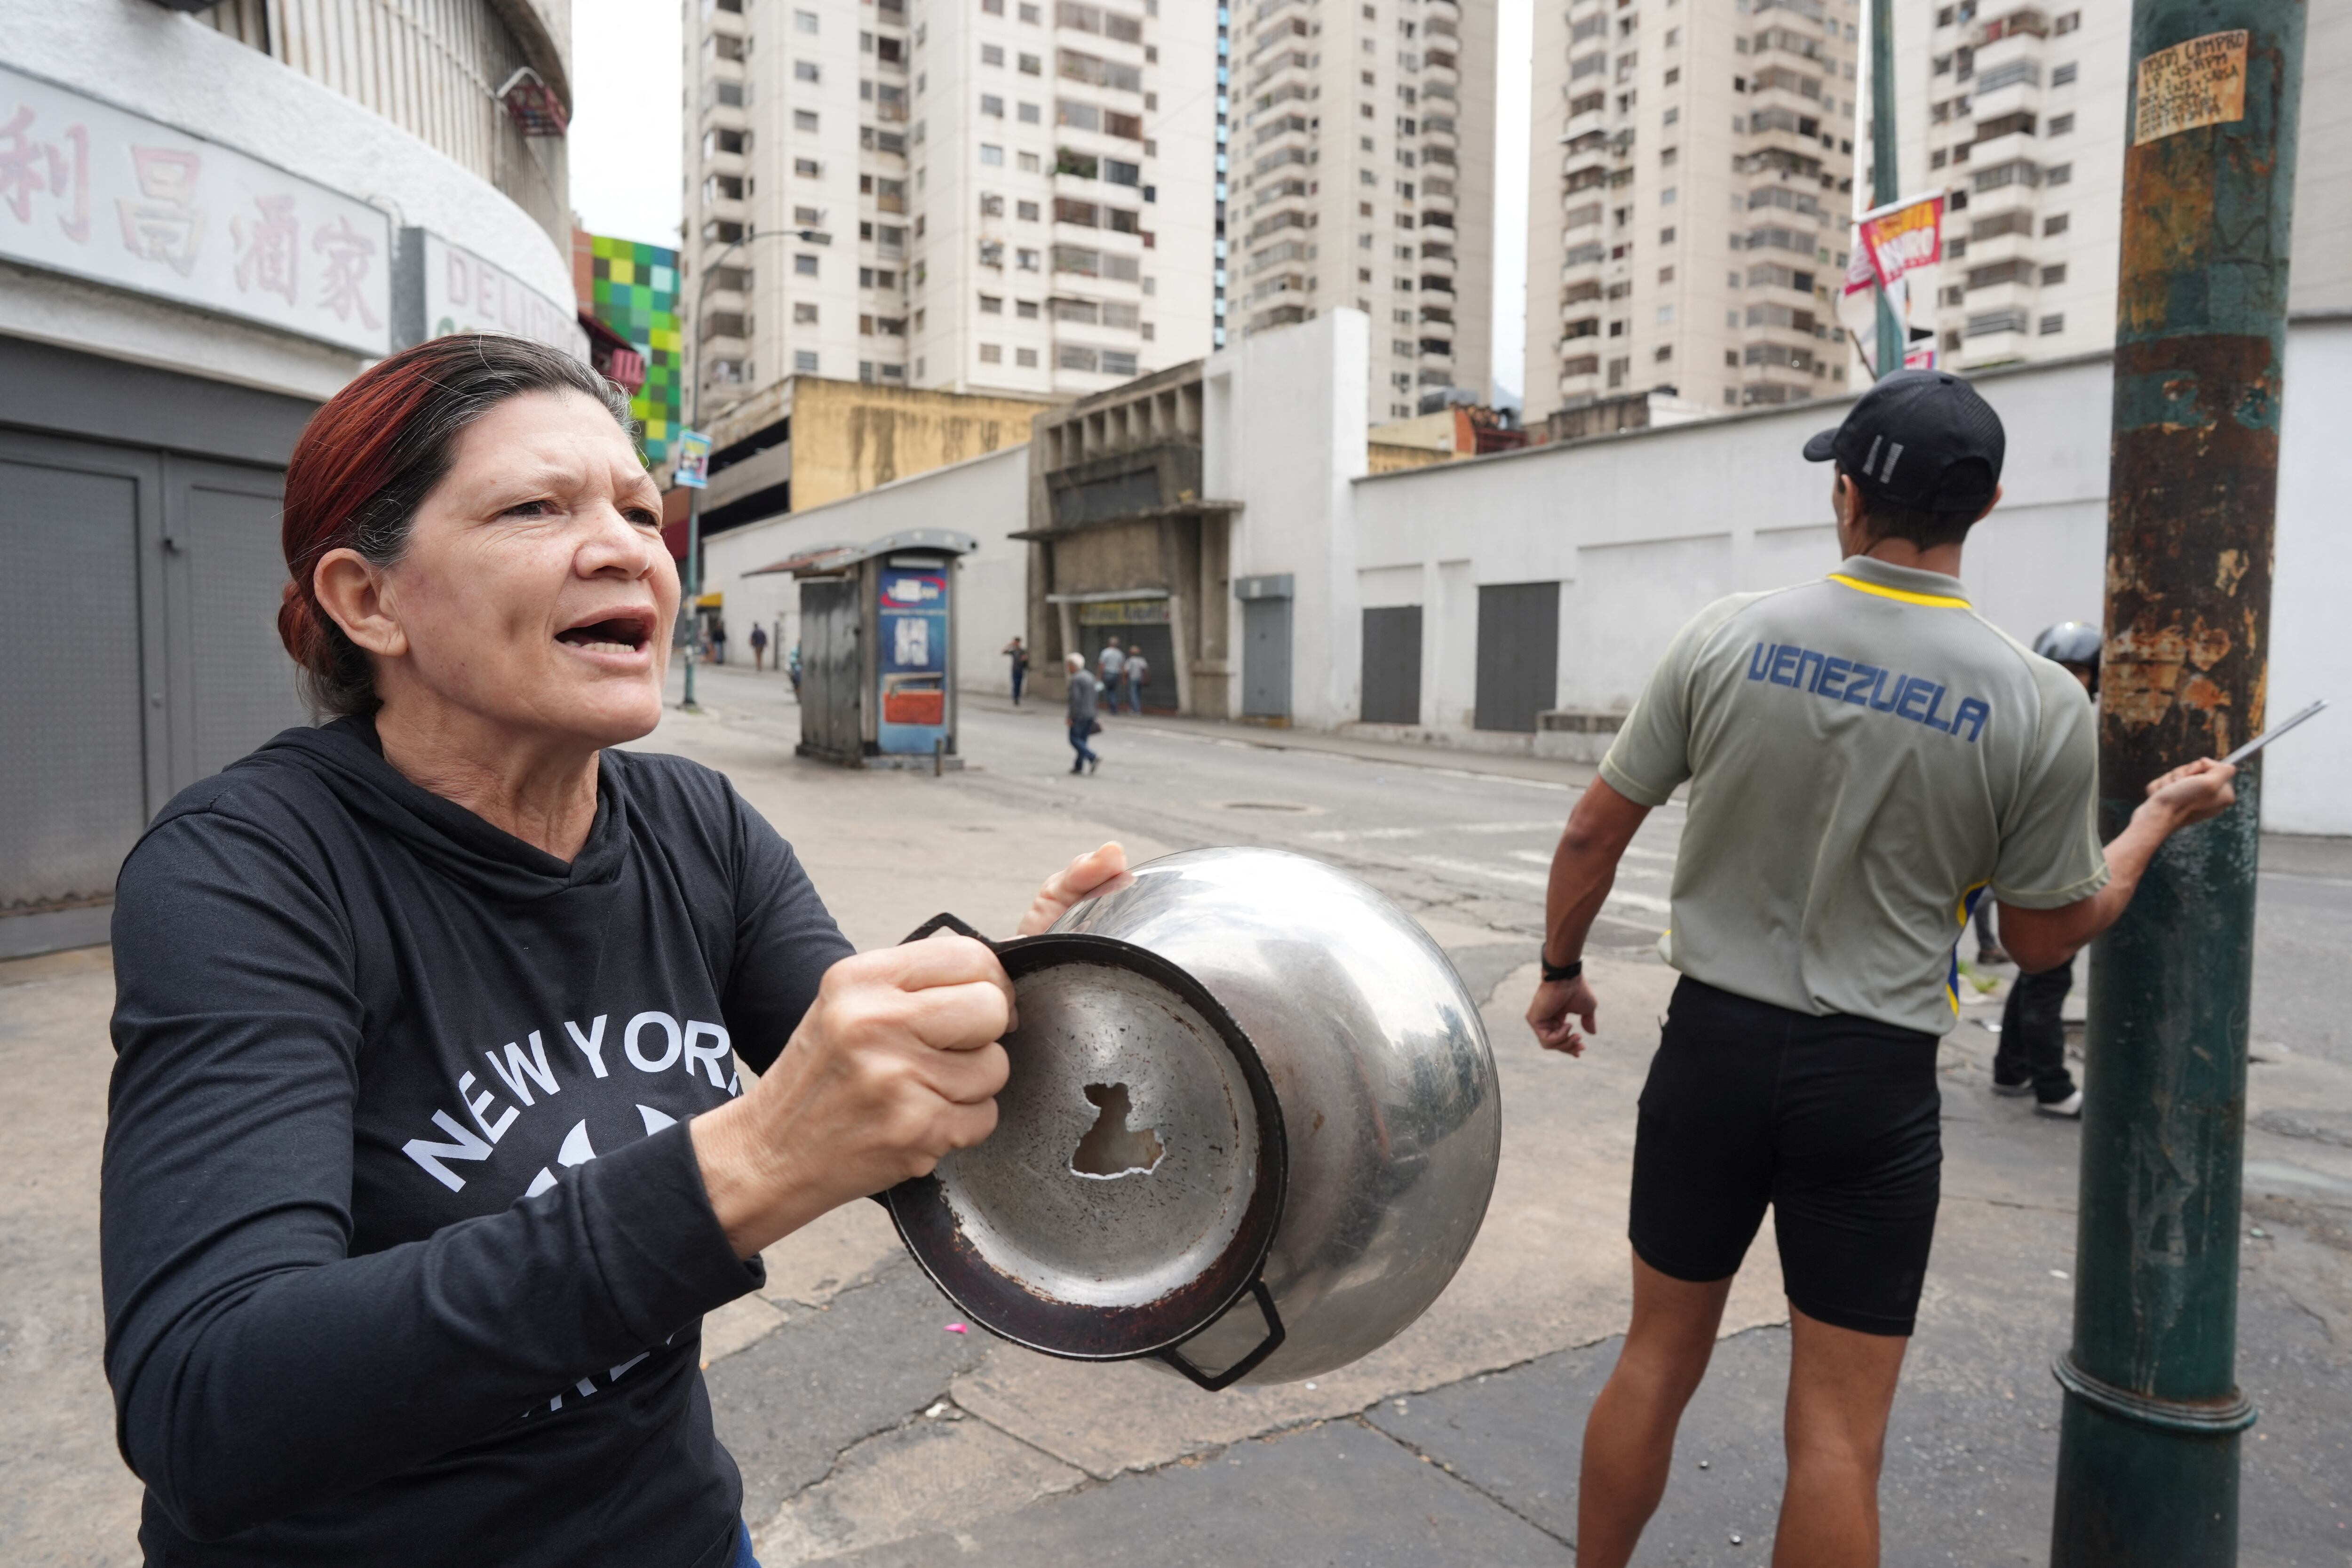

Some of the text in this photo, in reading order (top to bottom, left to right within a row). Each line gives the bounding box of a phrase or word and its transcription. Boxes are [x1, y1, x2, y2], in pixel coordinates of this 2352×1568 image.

[2185, 32, 2245, 59] COMPRO
[1748, 642, 1990, 743] VENEZUELA
[401, 1011, 742, 1193] NEW YOR
